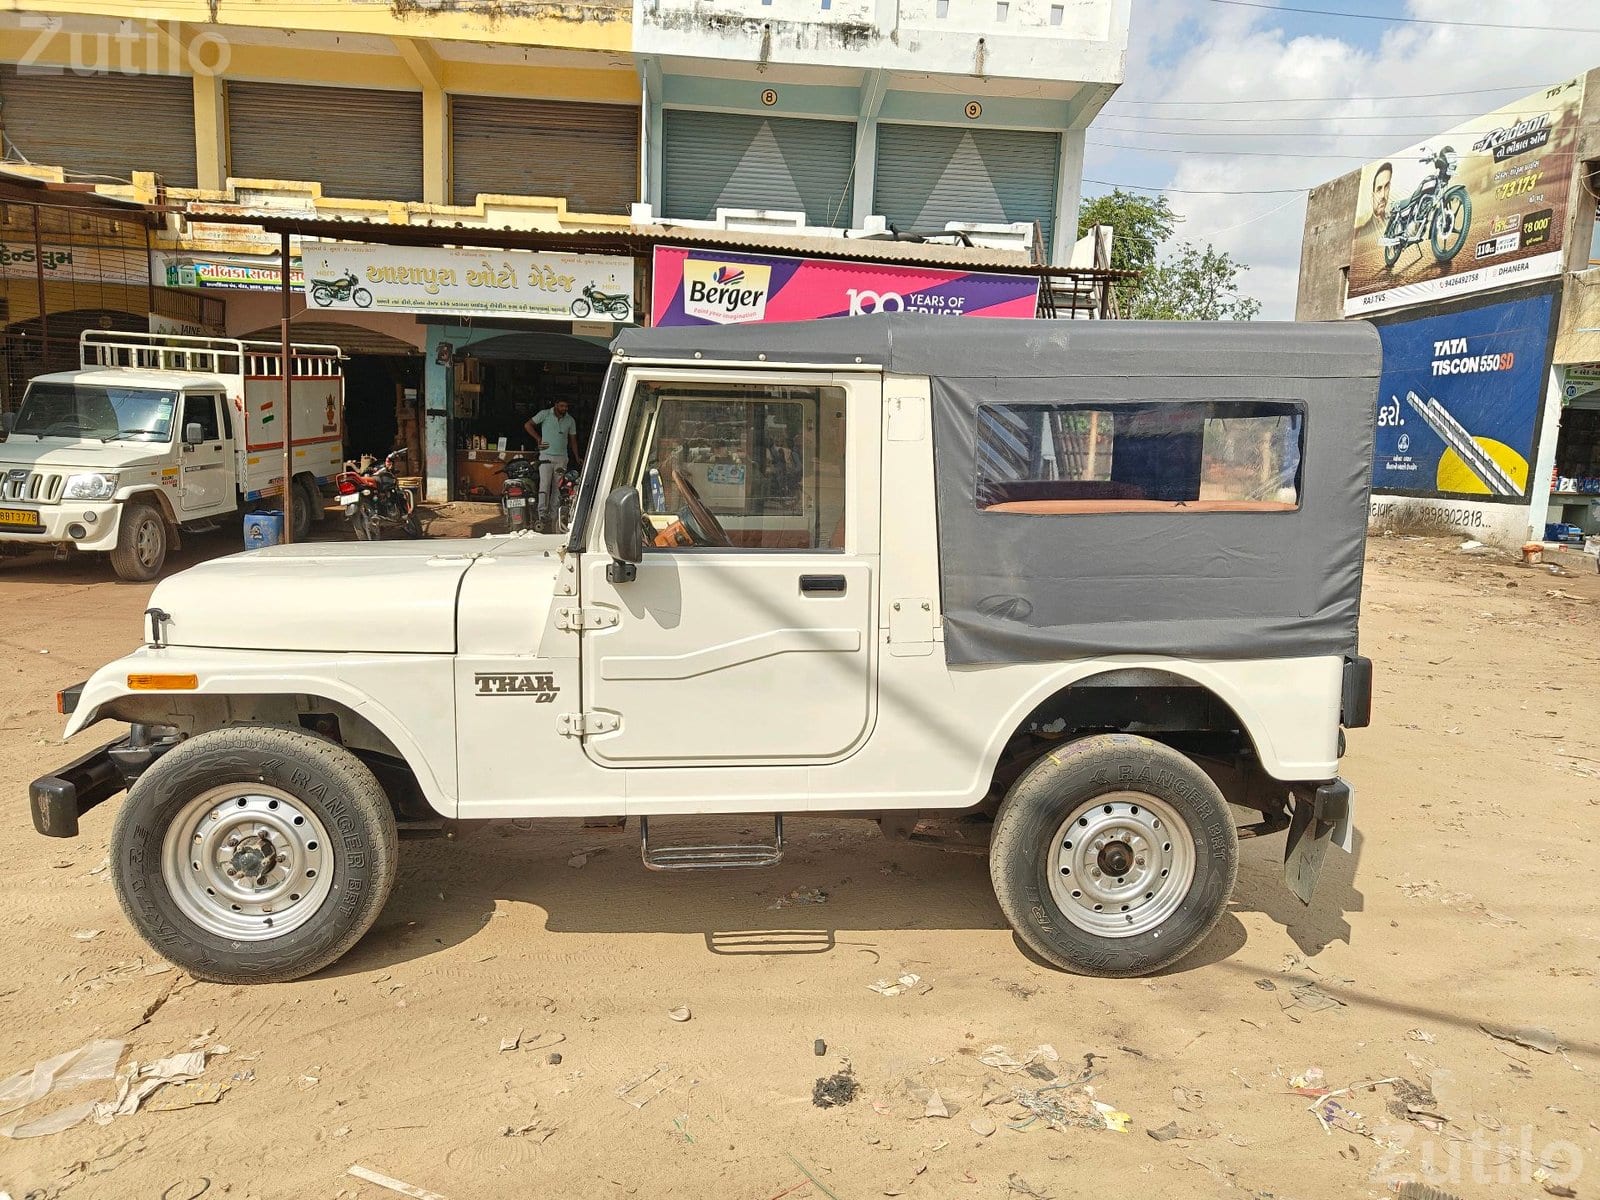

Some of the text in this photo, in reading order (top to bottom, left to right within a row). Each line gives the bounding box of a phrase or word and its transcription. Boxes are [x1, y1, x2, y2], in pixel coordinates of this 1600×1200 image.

[765, 91, 774, 102] 8
[1545, 86, 1562, 99] TVS
[969, 105, 978, 115] 9
[1480, 113, 1550, 152] Radeon
[365, 260, 577, 295] આશાપુરા ઓટો ગેરેજ
[1498, 262, 1529, 276] DHANERA
[689, 280, 764, 312] Berger
[846, 288, 905, 317] 100
[910, 293, 965, 308] YEARS OF
[1433, 337, 1468, 357] TATA
[1431, 356, 1480, 376] TISCON
[475, 676, 560, 692] THAR
[535, 693, 557, 703] DI
[1118, 765, 1216, 821] RANGER
[290, 767, 365, 869] RANGER
